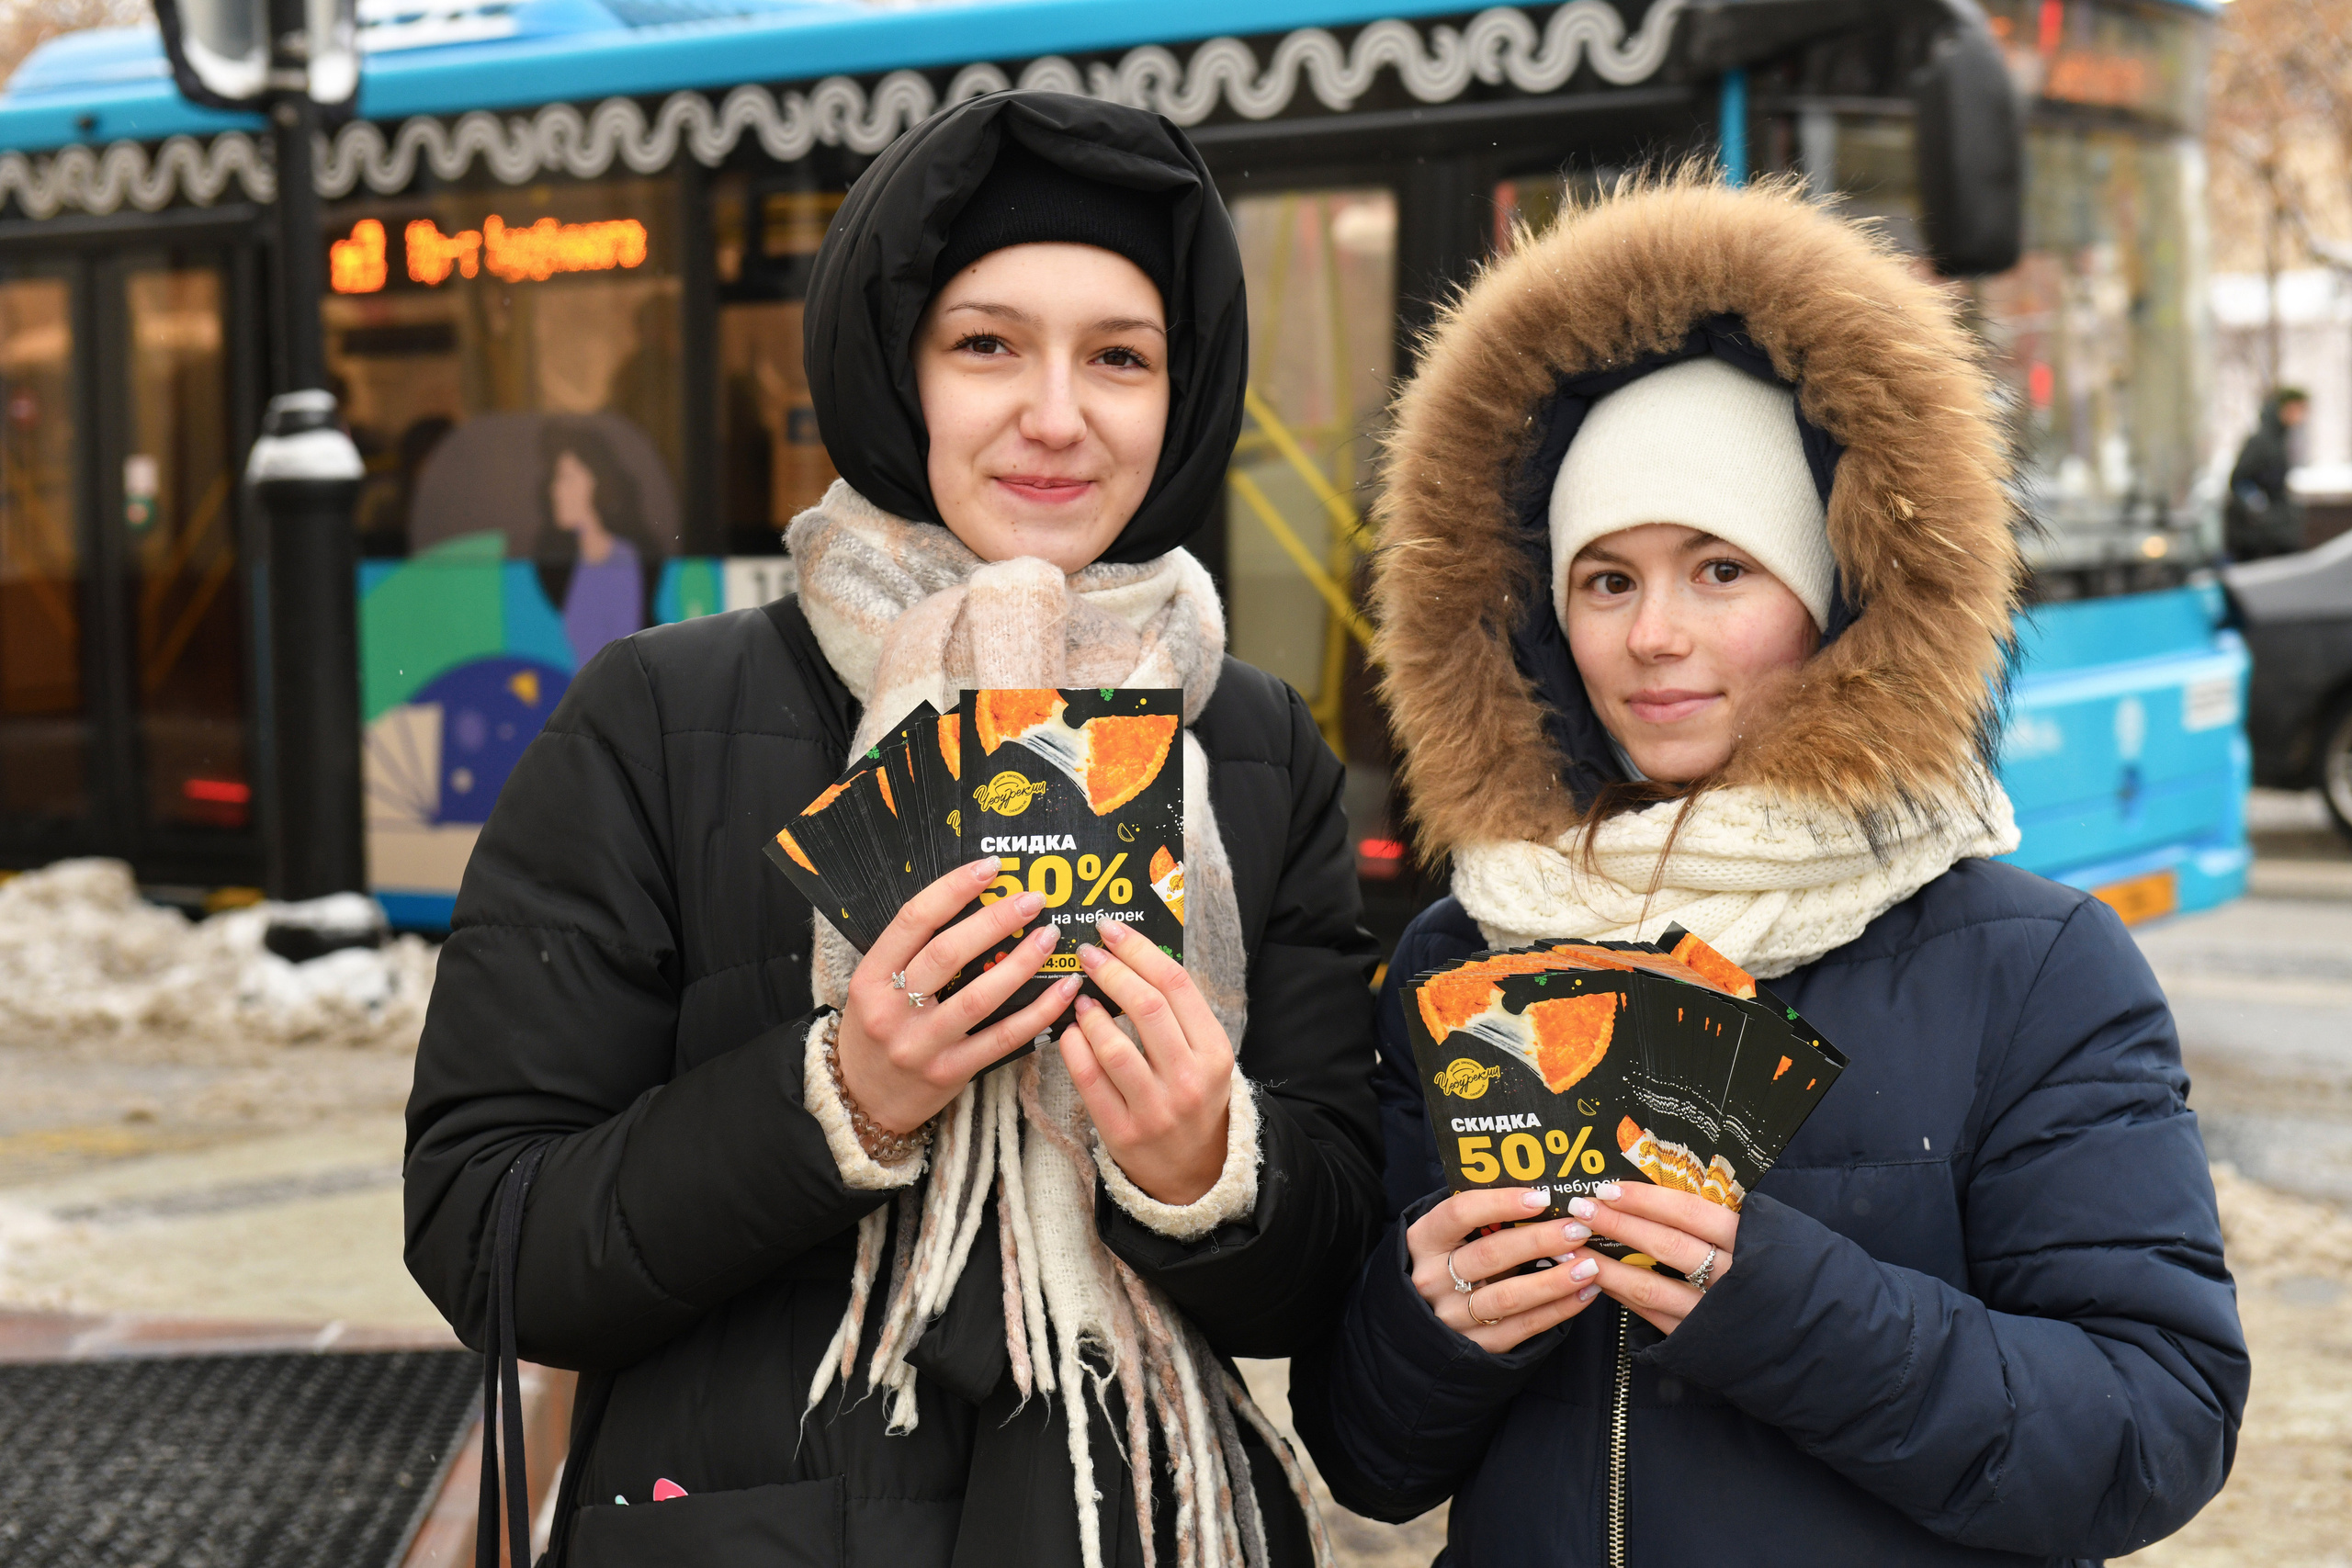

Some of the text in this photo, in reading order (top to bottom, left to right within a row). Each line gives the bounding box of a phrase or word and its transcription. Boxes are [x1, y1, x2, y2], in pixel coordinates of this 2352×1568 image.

[980, 834, 1077, 854] СКИДКА
[979, 852, 1133, 908] 50%
[1051, 913, 1071, 925] на
[1451, 1112, 1542, 1133] СКИДКА
[1458, 1126, 1605, 1183] 50%
